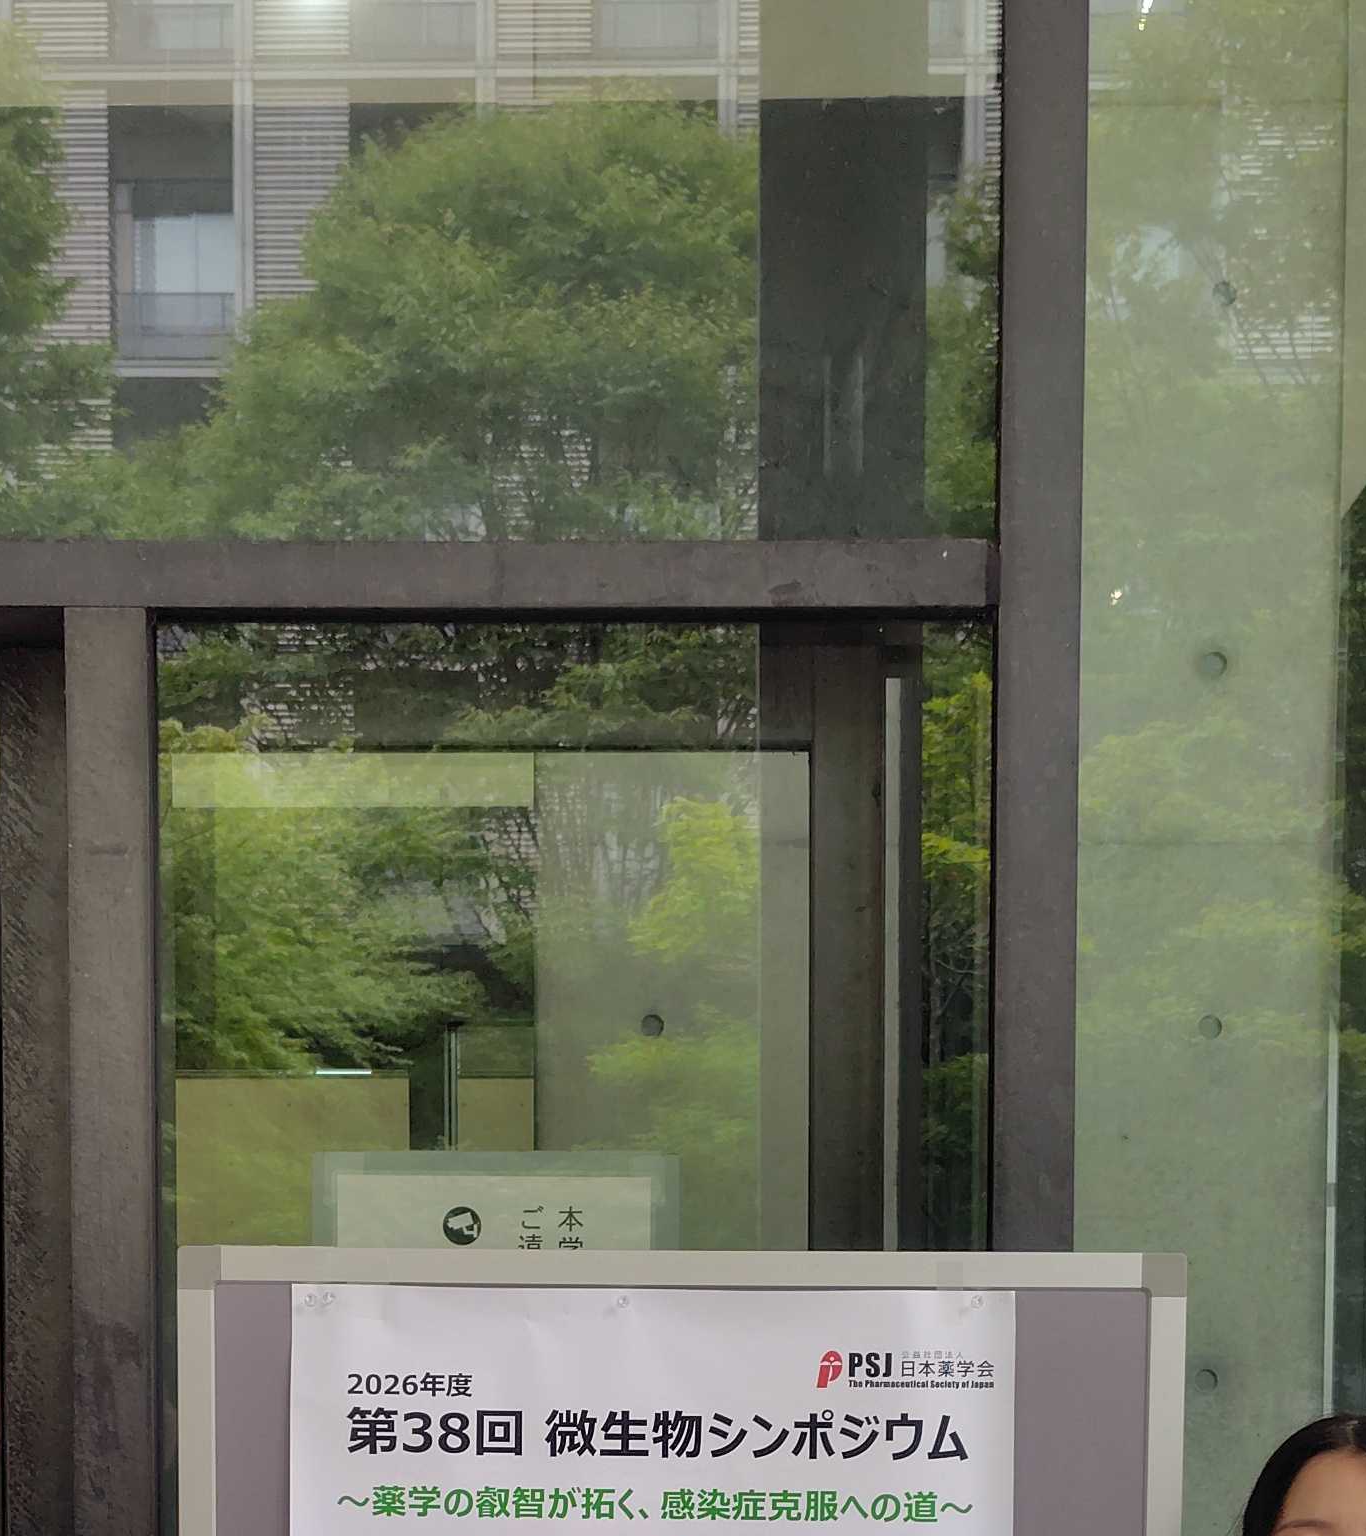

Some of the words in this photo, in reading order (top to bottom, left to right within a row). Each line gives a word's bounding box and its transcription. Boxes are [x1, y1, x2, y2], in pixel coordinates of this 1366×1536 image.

[848, 1352, 893, 1378] PSJ
[901, 1360, 995, 1378] 日本薬学会
[347, 1371, 473, 1398] 2026年度
[848, 1379, 863, 1388] The
[865, 1379, 929, 1388] Pharmaceutical
[930, 1380, 960, 1390] Society
[961, 1380, 970, 1389] of
[971, 1380, 995, 1389] Japan
[346, 1406, 523, 1456] 第38回
[545, 1408, 969, 1462] 微生物シンポジウム
